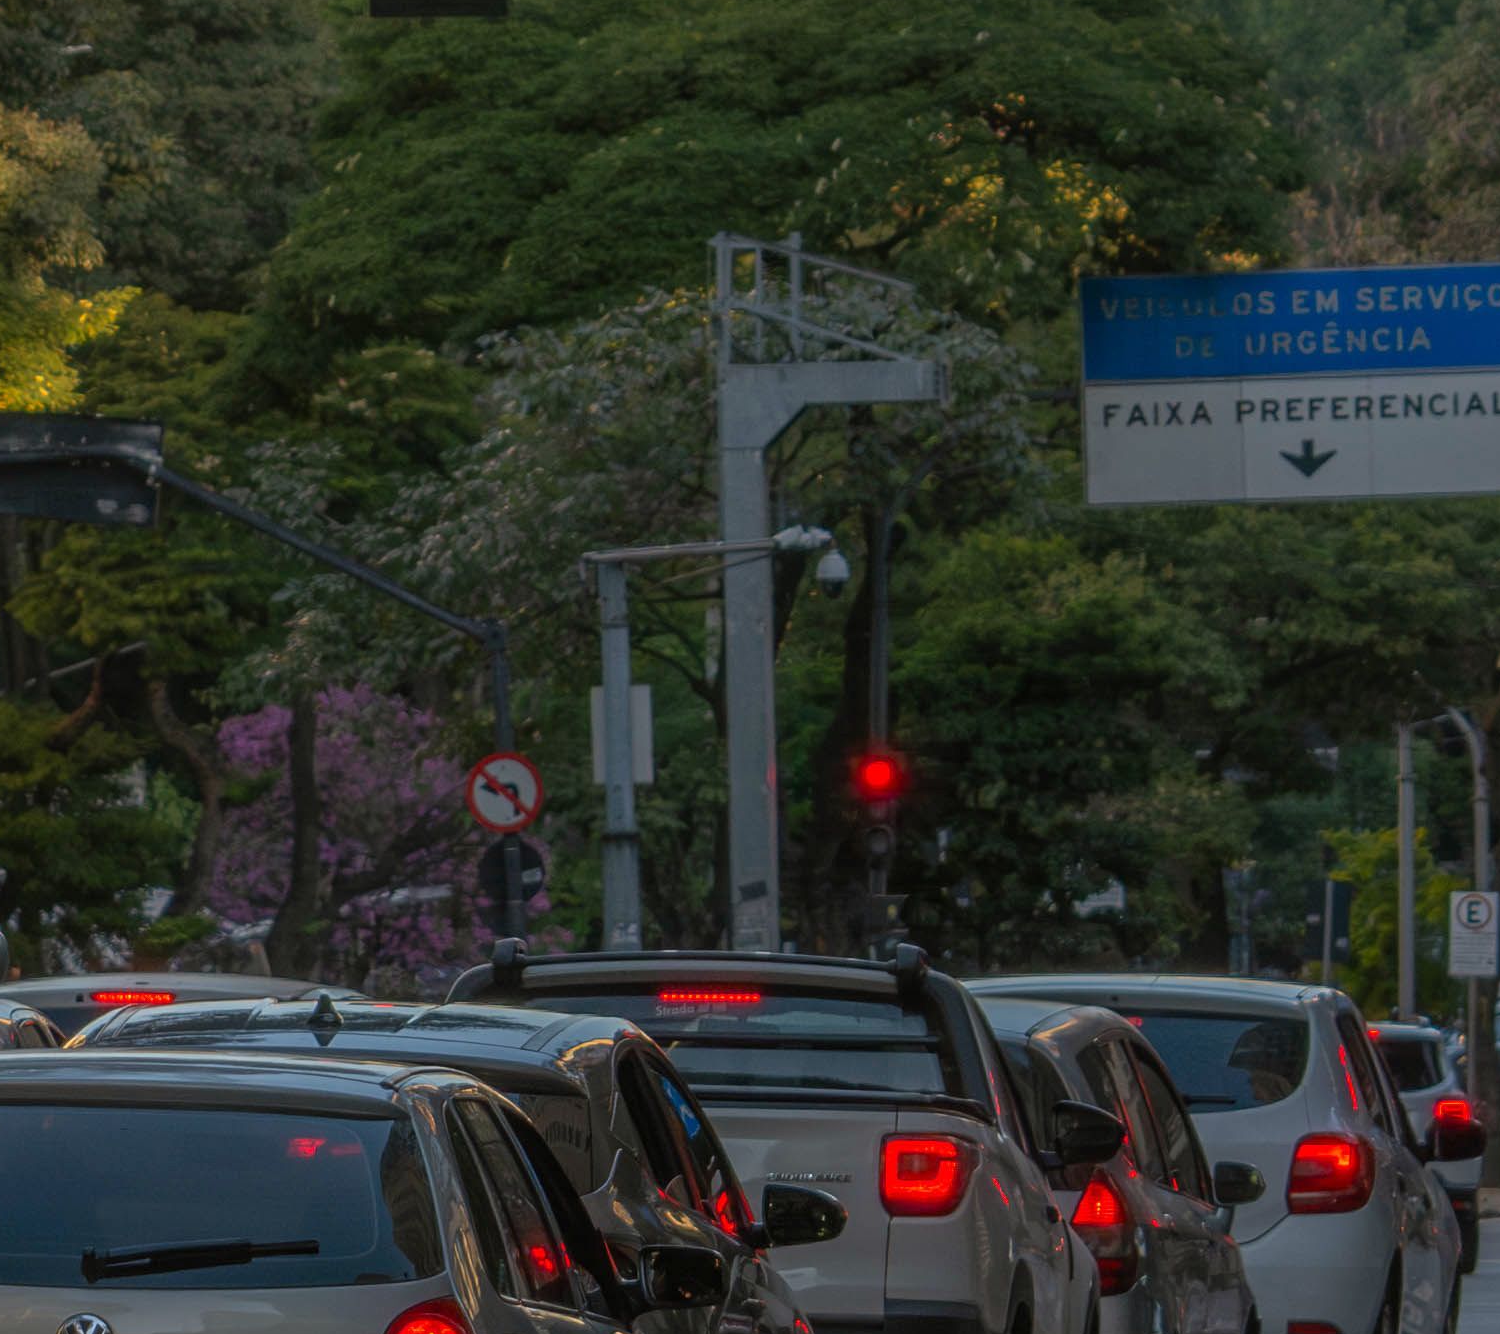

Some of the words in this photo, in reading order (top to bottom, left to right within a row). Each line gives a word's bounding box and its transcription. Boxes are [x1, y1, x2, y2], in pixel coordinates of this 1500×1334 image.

[1291, 288, 1340, 315] EM
[1245, 322, 1431, 355] URGÊNCIA
[1103, 401, 1212, 427] FAIXA
